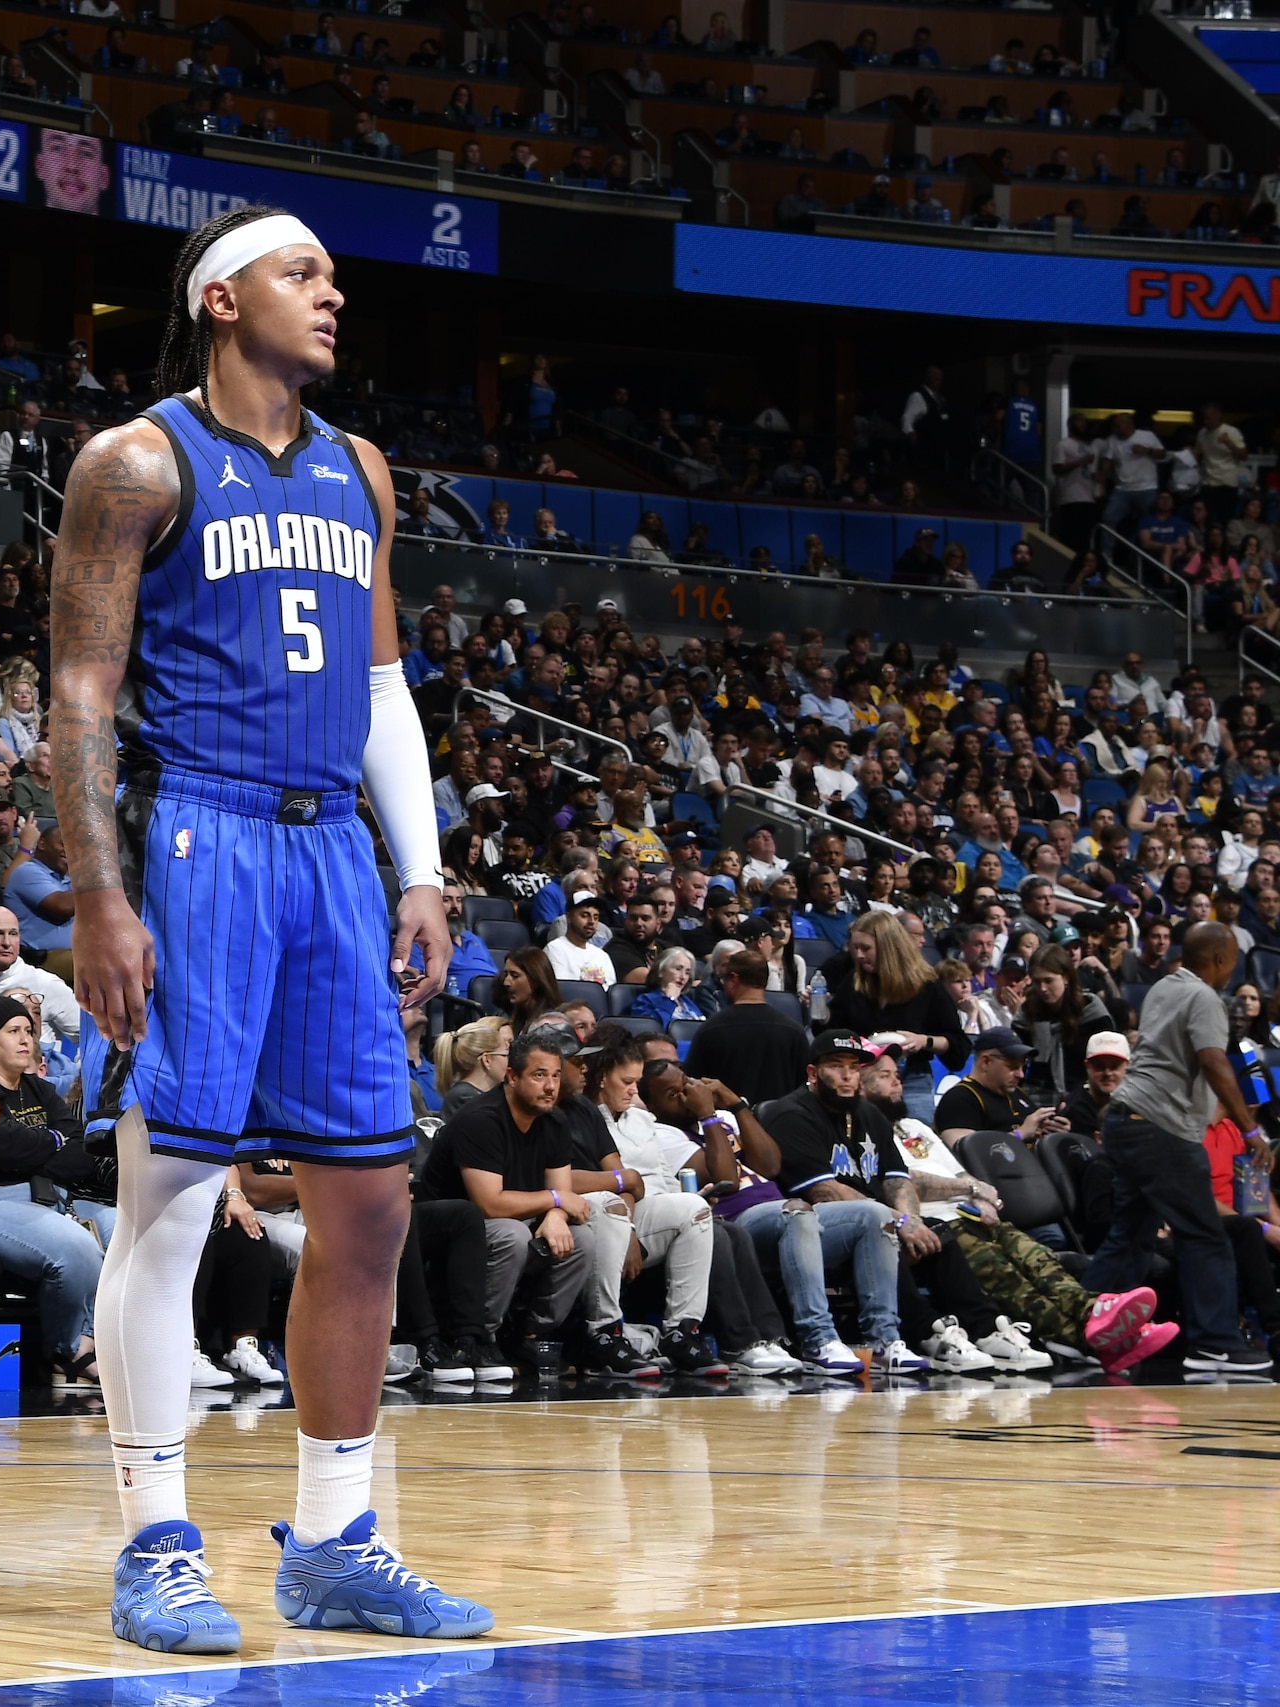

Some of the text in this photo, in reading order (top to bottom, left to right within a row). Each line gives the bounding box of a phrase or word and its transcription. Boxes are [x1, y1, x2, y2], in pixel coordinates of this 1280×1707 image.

[122, 146, 171, 182] FRANZ
[122, 176, 248, 232] WAGNE
[431, 202, 462, 246] 2
[421, 245, 470, 270] ASTS
[1127, 268, 1280, 323] FRA
[202, 511, 373, 591] ORLANDO
[670, 583, 732, 622] 116
[278, 588, 325, 673] 5
